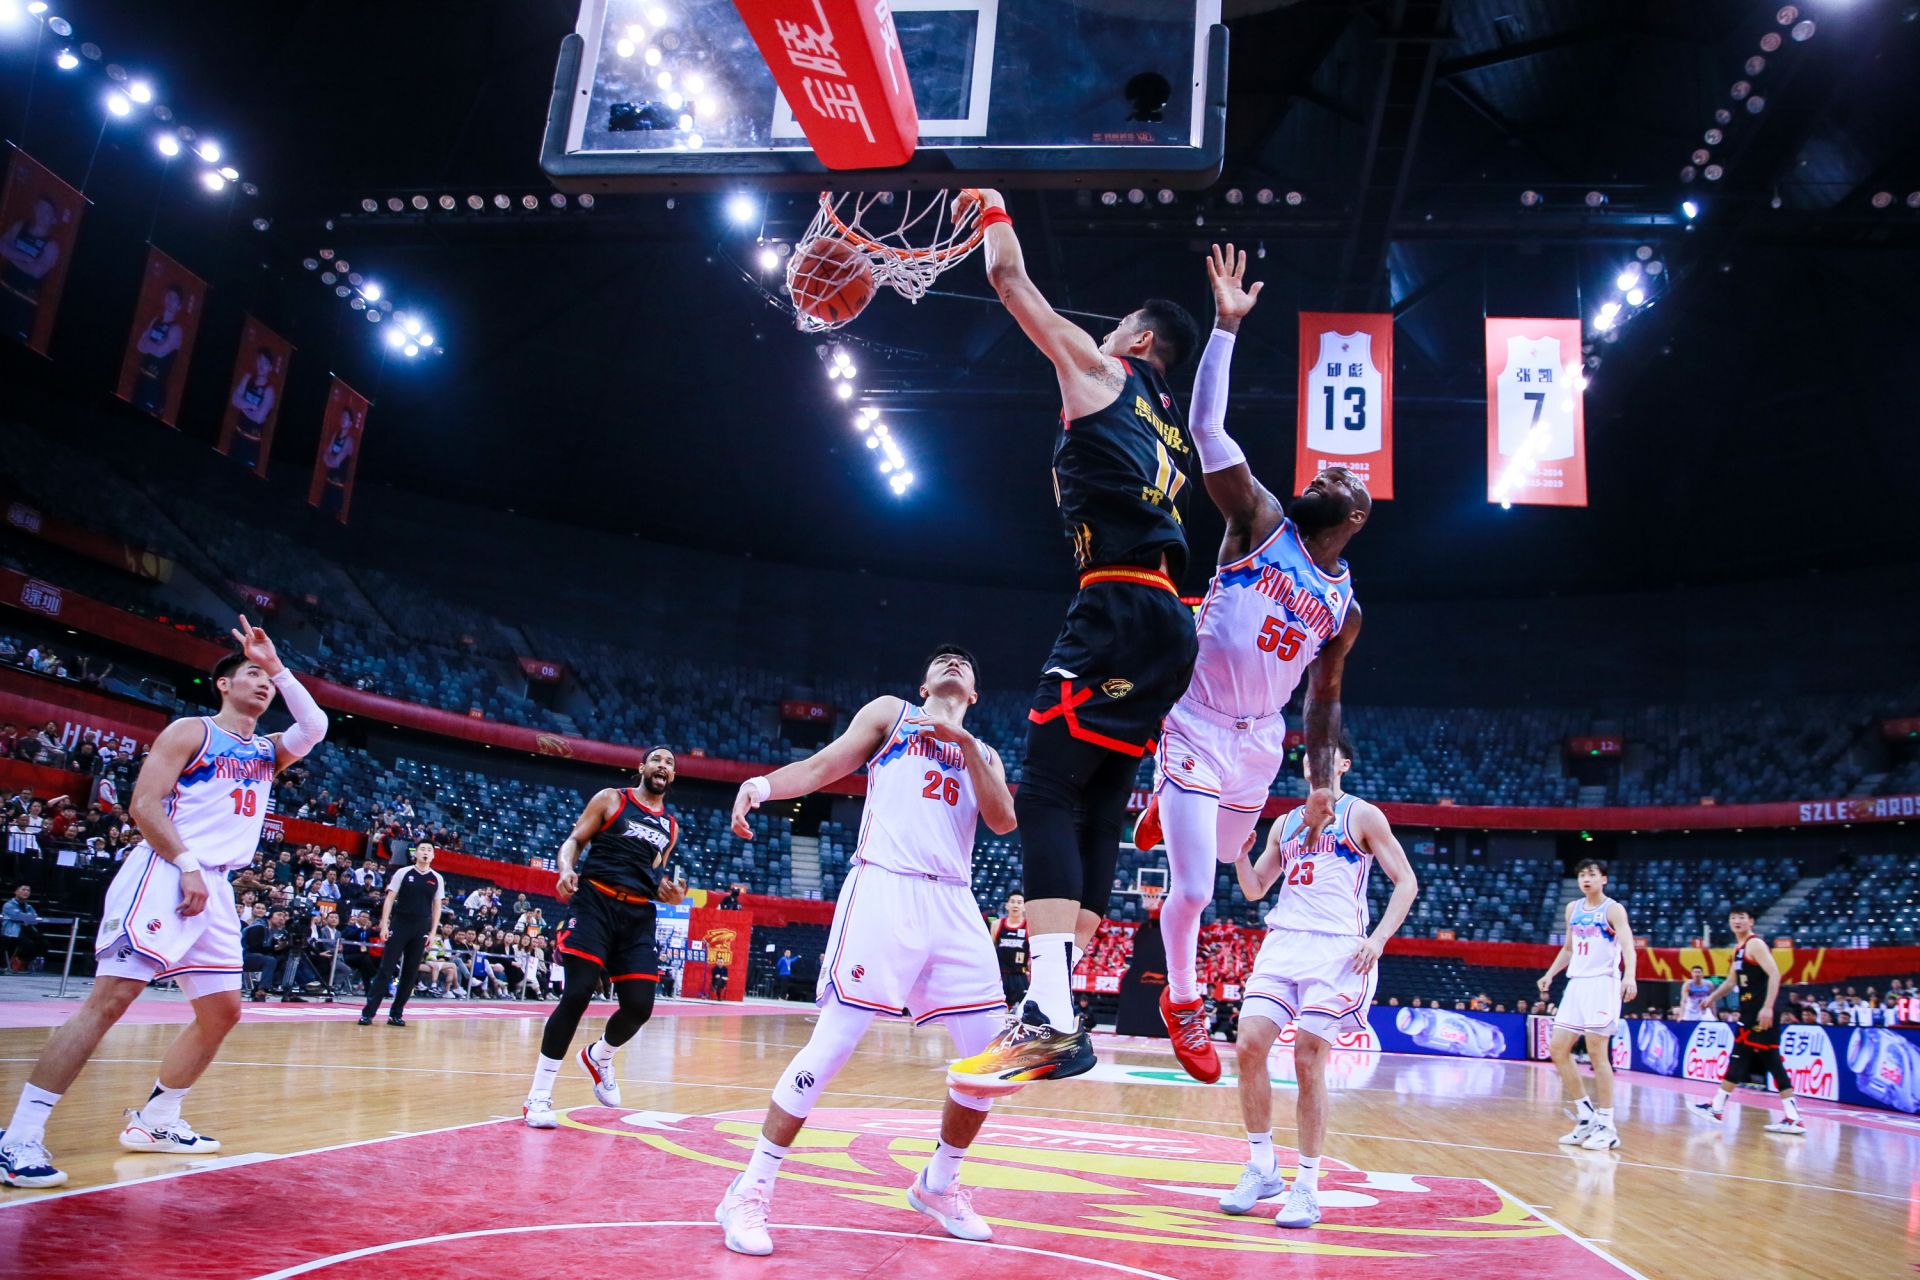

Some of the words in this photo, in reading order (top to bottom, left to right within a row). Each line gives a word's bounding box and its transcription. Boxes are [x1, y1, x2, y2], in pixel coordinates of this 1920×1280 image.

[1323, 385, 1367, 431] 13
[1523, 392, 1546, 430] 7
[1254, 563, 1337, 640] XINJIANG
[1257, 614, 1308, 662] 55
[229, 787, 257, 818] 19
[922, 770, 961, 807] 26
[1287, 861, 1315, 886] 23
[1577, 941, 1589, 956] 11
[1783, 1030, 1826, 1057] 百岁山
